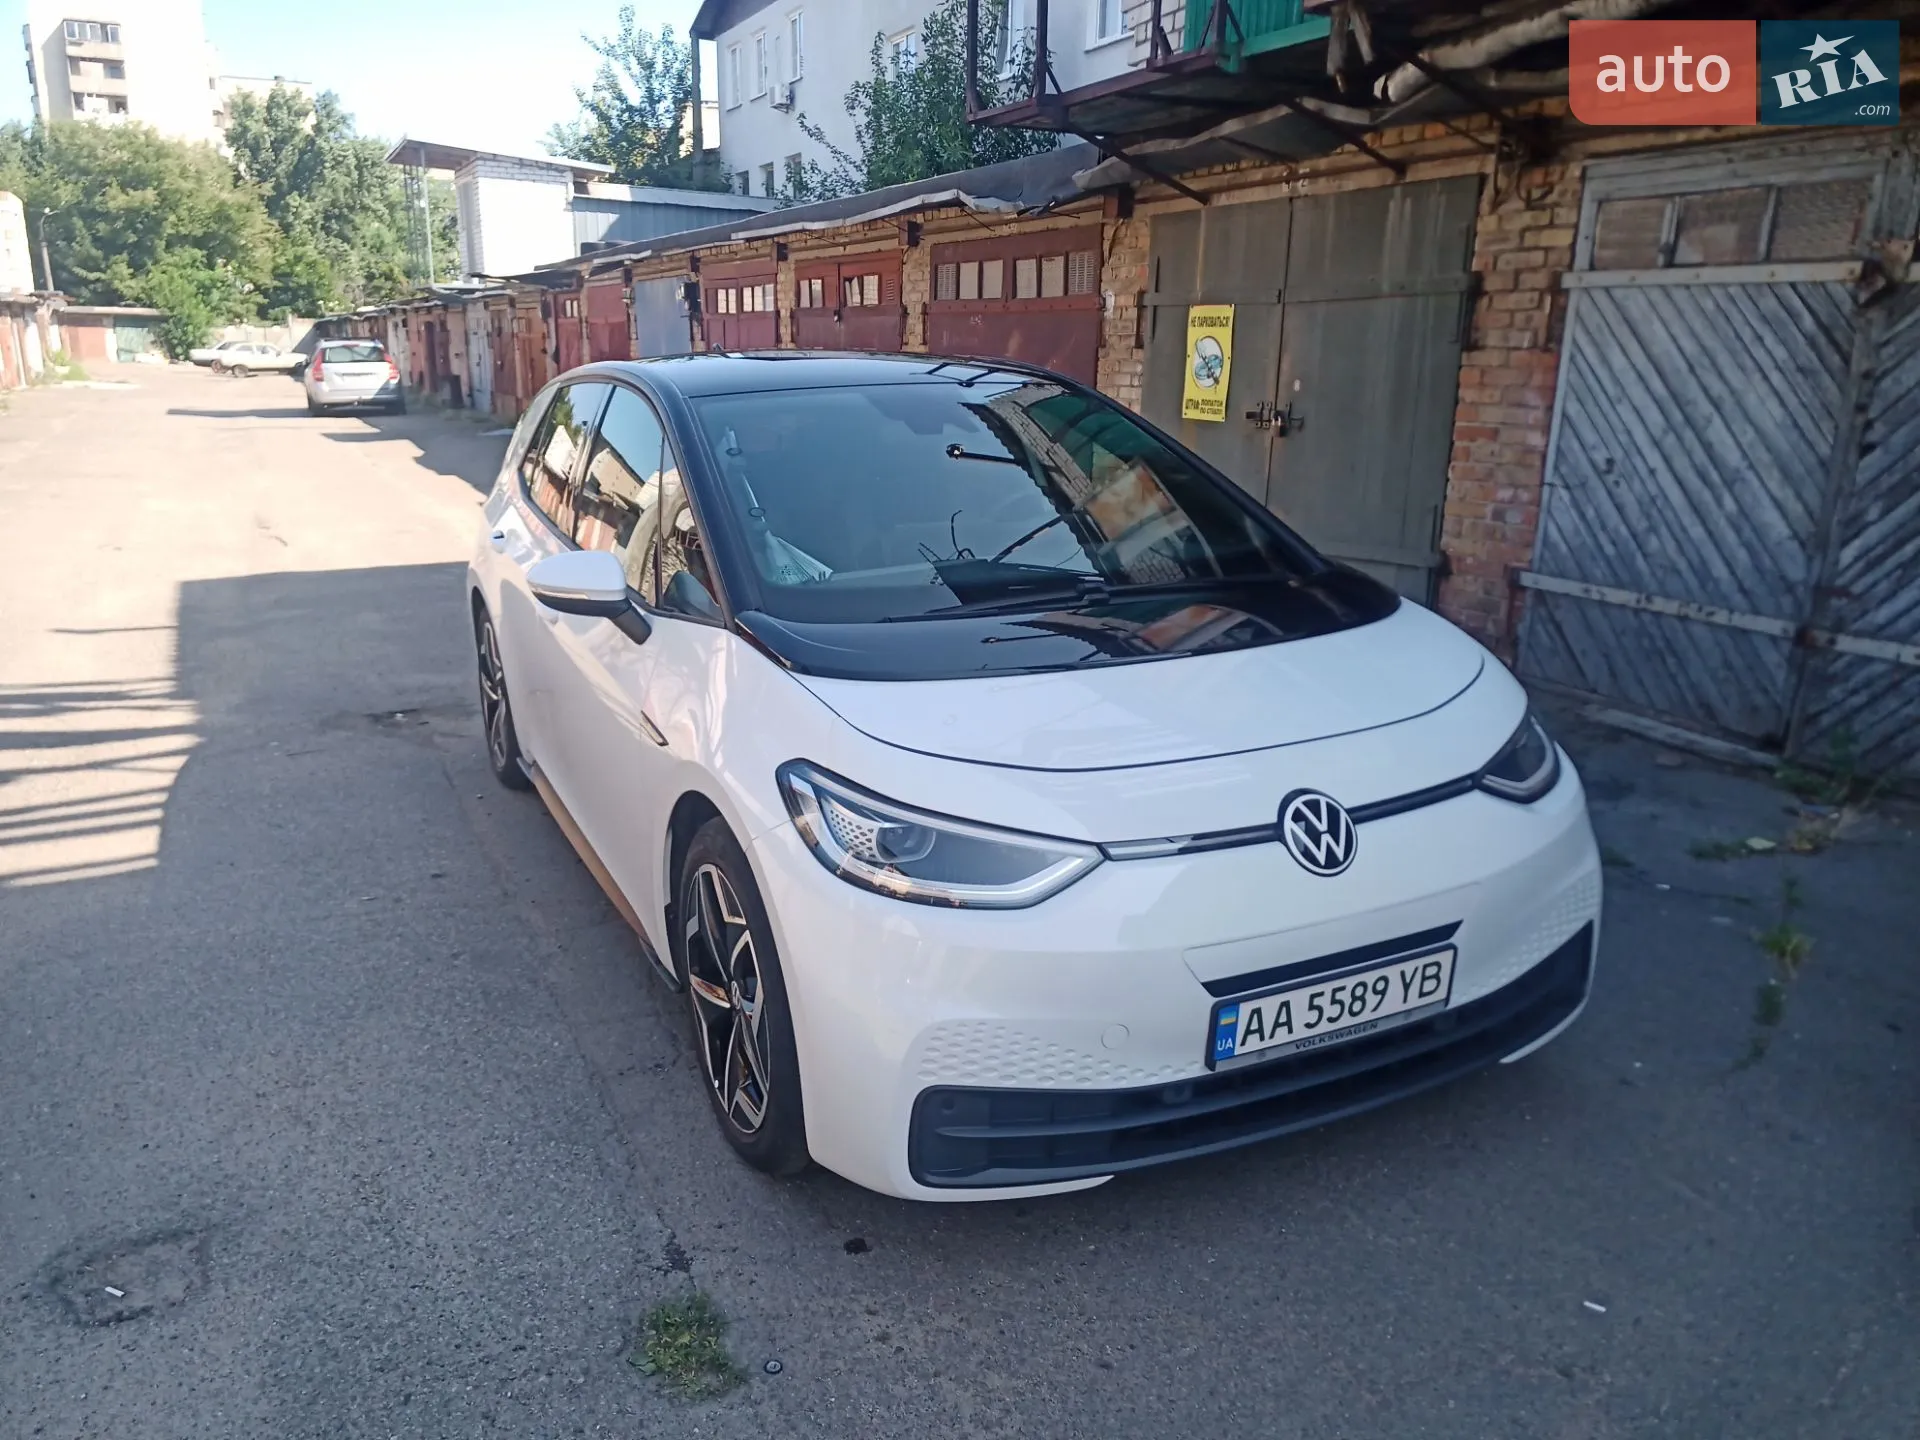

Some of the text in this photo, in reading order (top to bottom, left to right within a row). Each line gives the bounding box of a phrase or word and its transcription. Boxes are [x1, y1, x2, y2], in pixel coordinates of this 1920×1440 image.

[1191, 316, 1197, 328] НЕ
[1240, 960, 1443, 1047] AA 5589 YB
[1217, 1037, 1233, 1051] UA
[1294, 1022, 1379, 1051] VOLKSWAGEN
